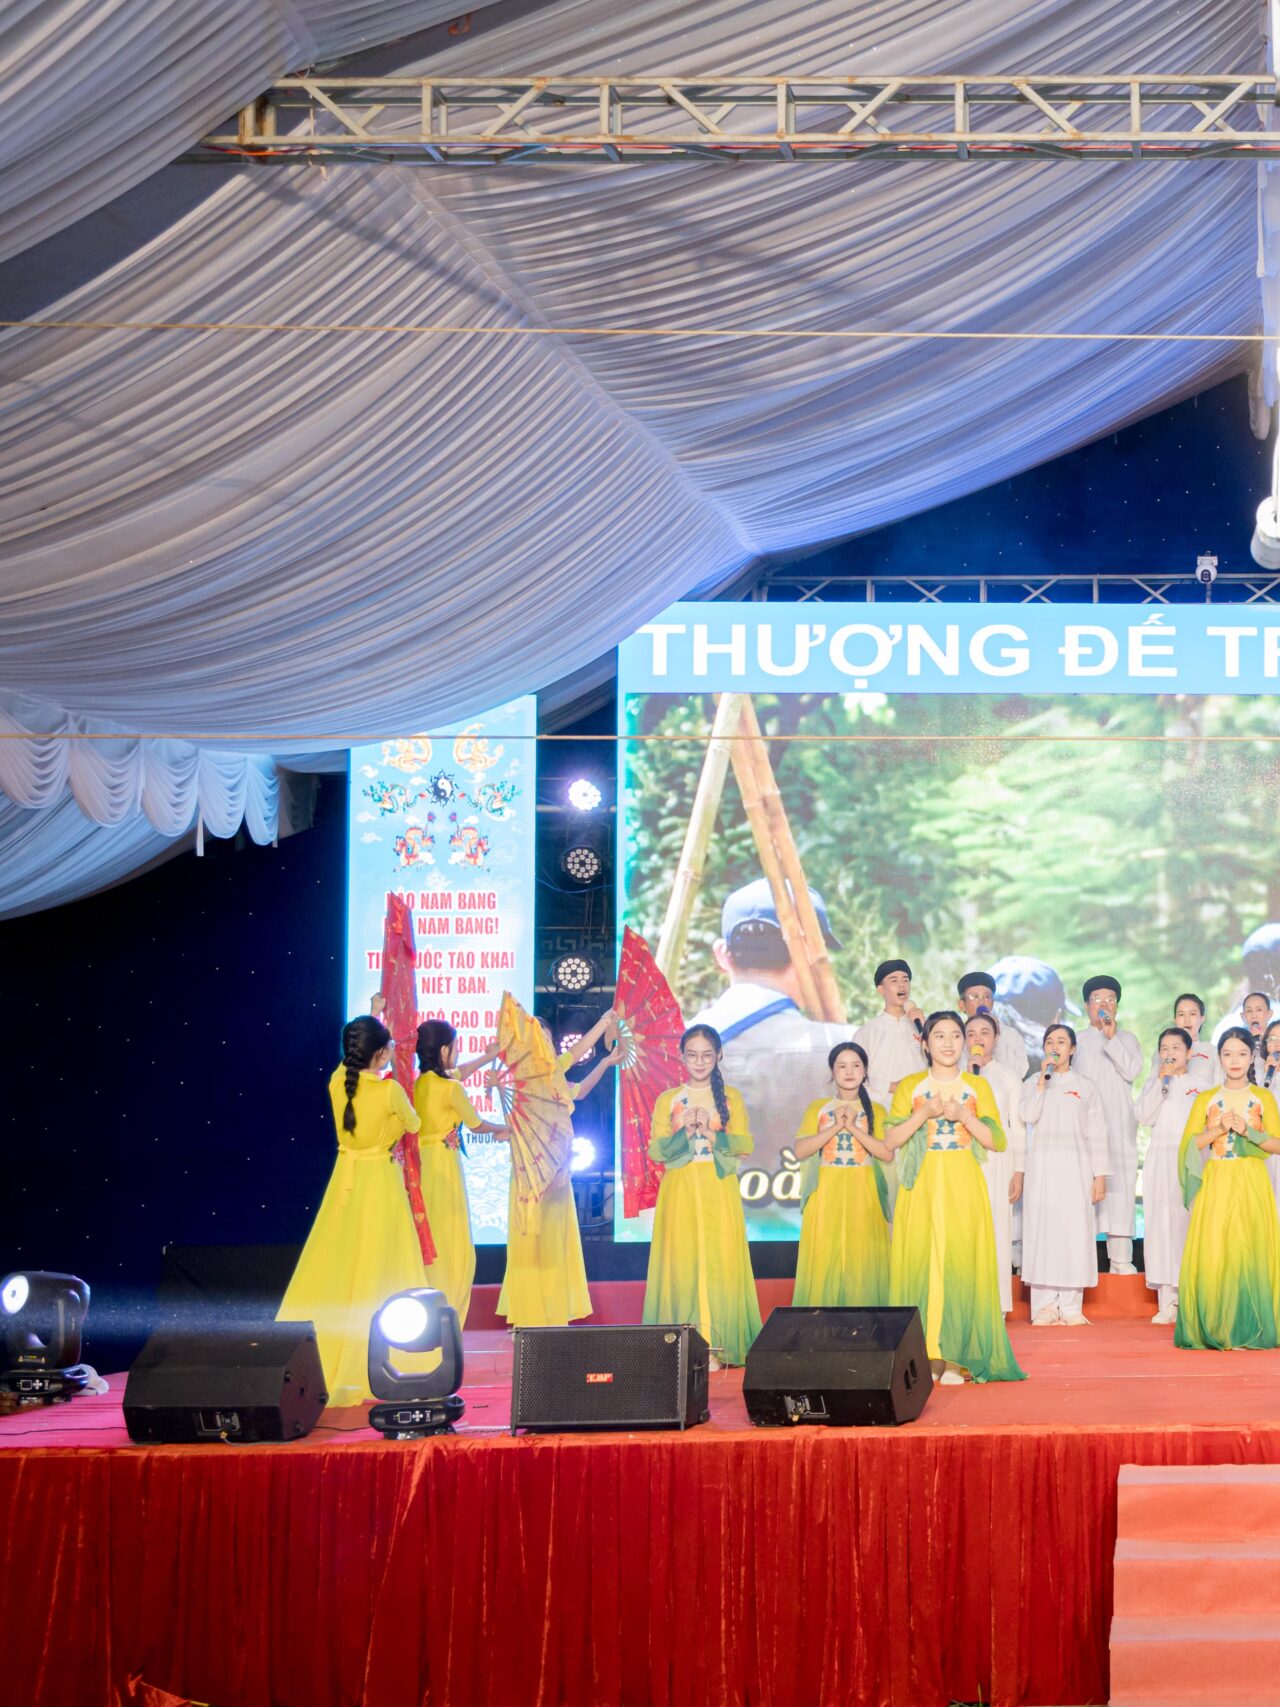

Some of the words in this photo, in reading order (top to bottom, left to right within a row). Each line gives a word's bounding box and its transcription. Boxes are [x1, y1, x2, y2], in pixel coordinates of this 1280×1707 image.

[636, 623, 1031, 689] THƯỢNG
[1058, 613, 1178, 677] ĐẾ
[420, 892, 452, 910] NAM
[458, 892, 496, 910] BANG
[418, 917, 449, 935] NAM
[455, 917, 499, 935] BANG!
[480, 951, 515, 969] KHAI
[451, 1010, 479, 1028] CAO
